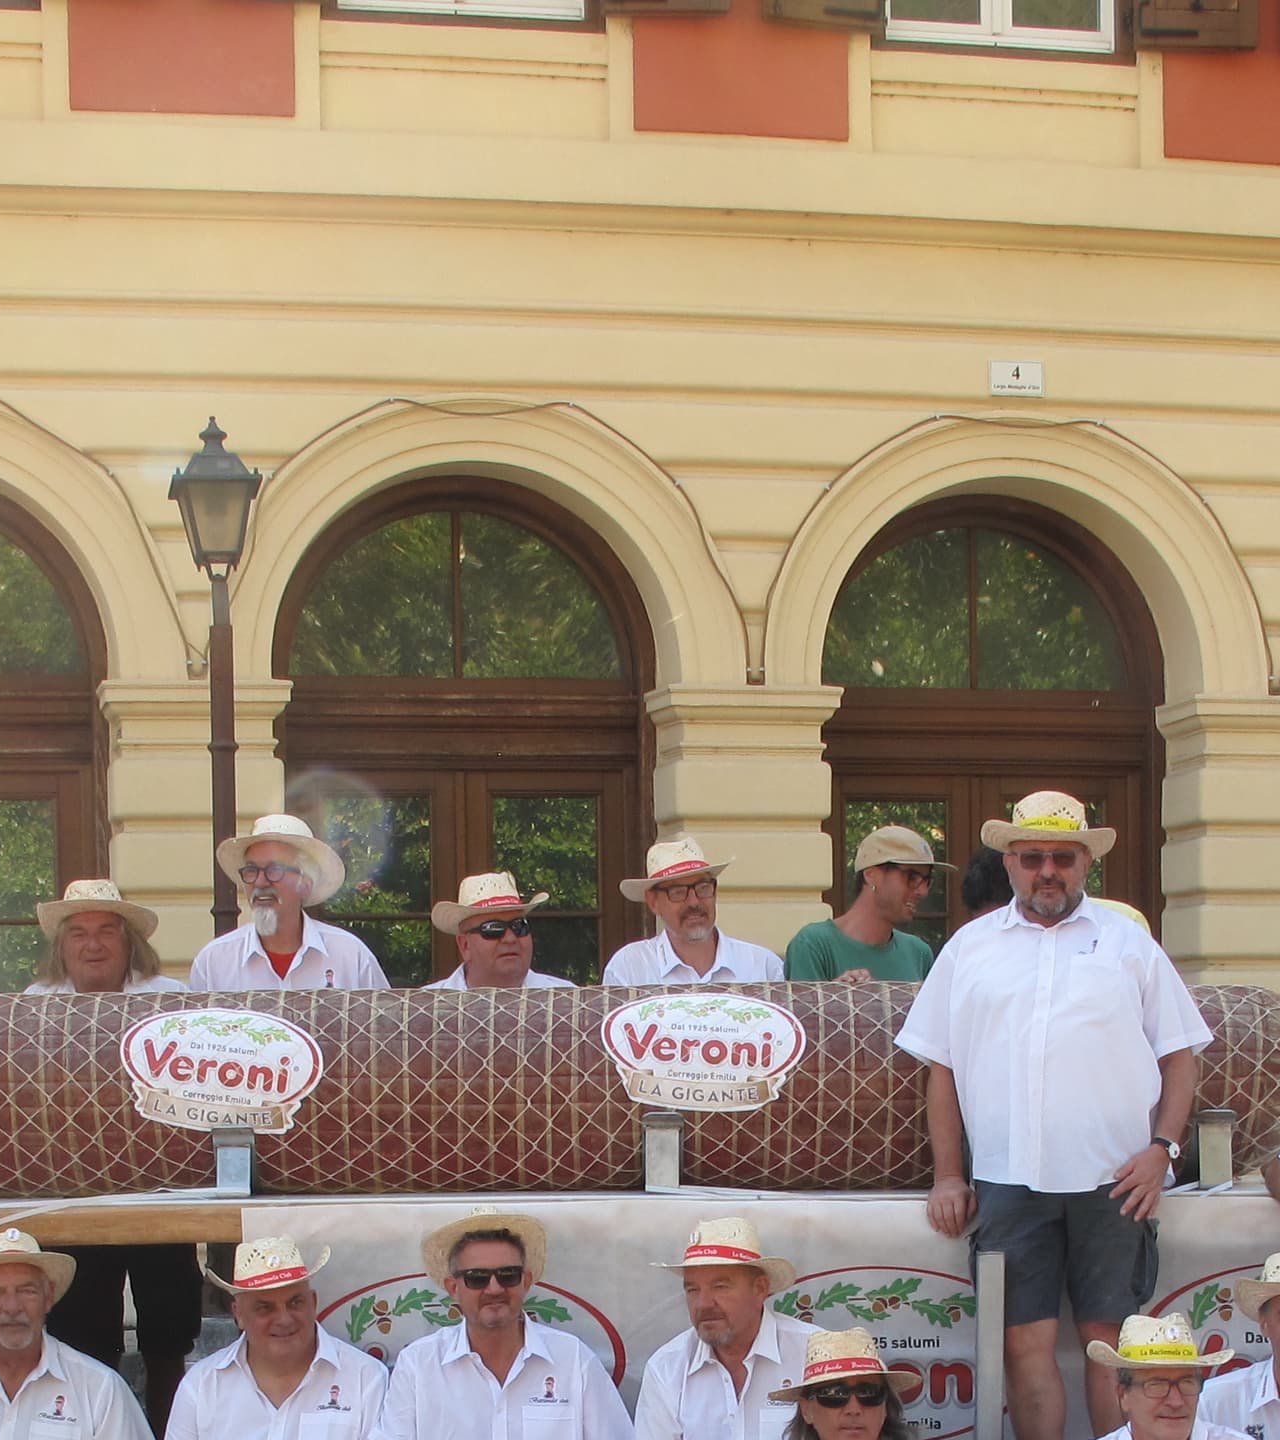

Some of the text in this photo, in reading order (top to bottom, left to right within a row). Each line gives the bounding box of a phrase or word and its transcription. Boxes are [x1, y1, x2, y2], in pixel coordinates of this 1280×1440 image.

[1011, 365, 1020, 380] 4
[623, 1022, 773, 1068] Veroni
[143, 1038, 291, 1094] Veroni
[638, 1079, 758, 1103] LA GIGANTE
[153, 1099, 272, 1126] LA GIGANTE
[872, 1335, 940, 1349] 25 salumi
